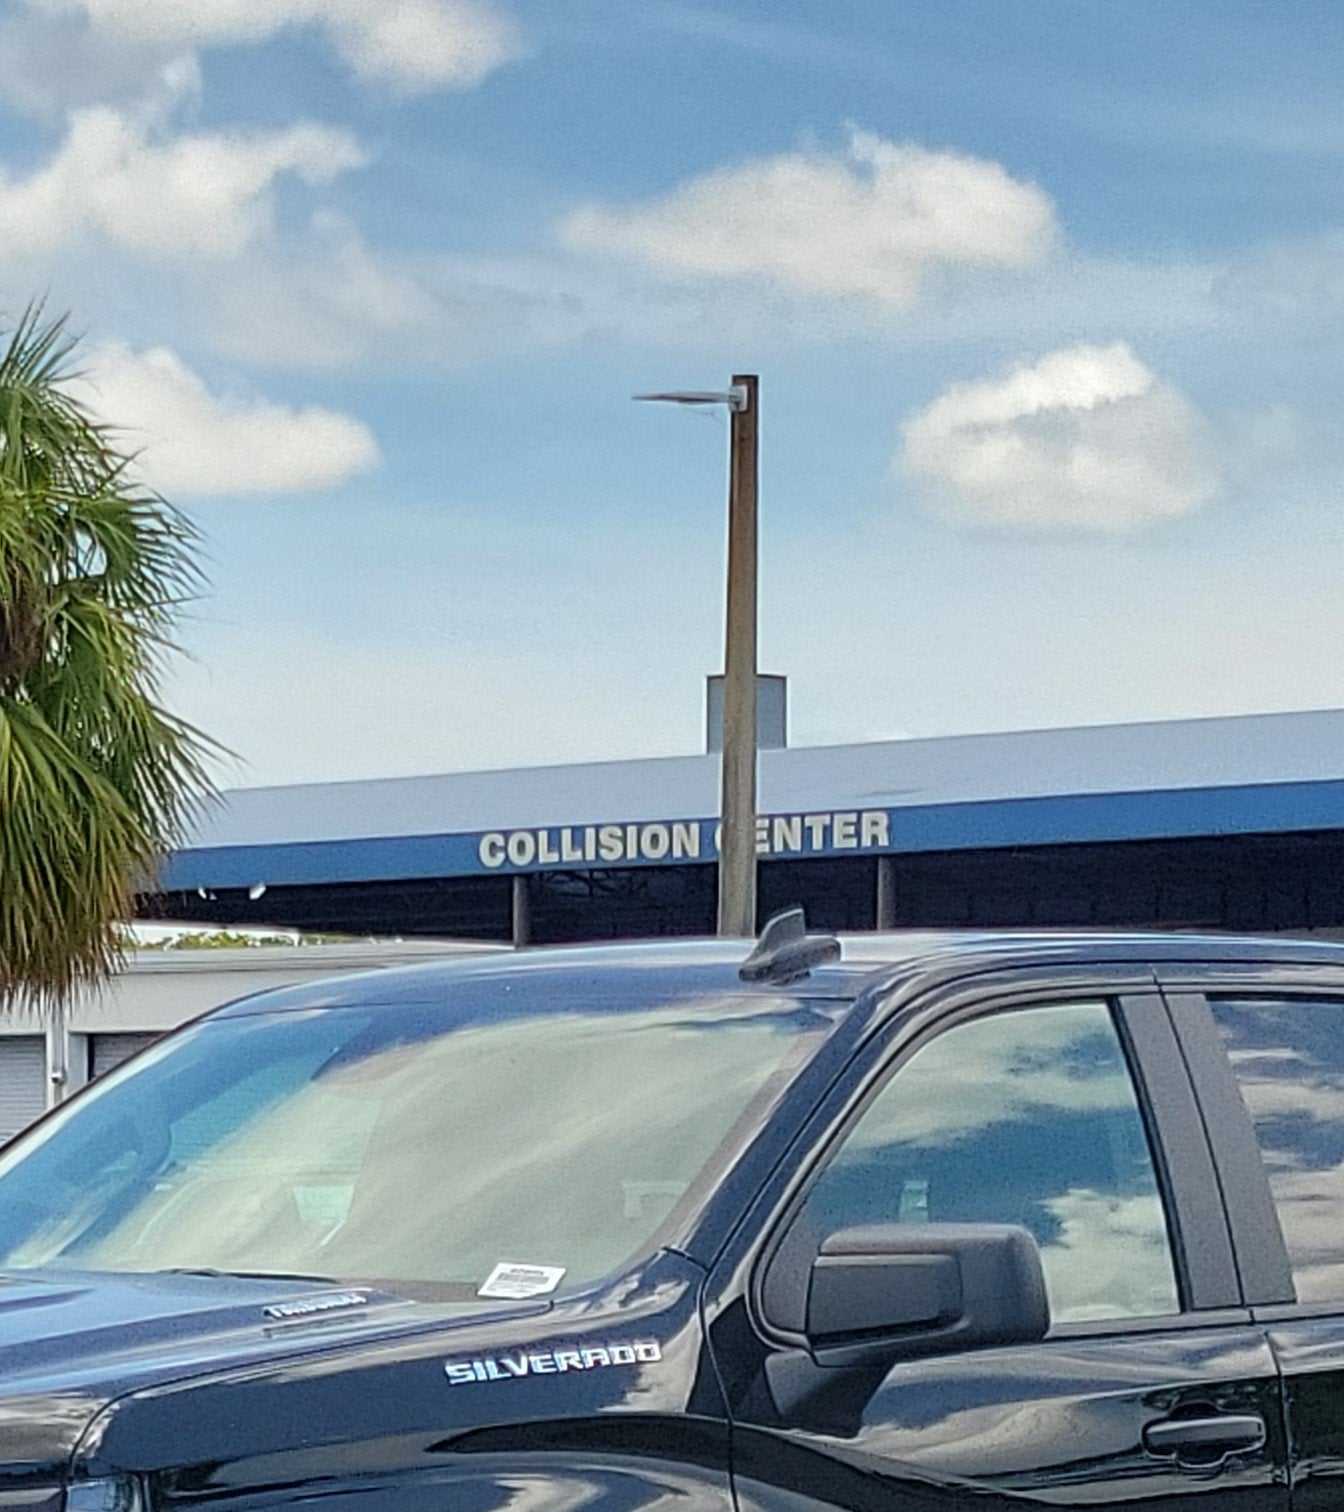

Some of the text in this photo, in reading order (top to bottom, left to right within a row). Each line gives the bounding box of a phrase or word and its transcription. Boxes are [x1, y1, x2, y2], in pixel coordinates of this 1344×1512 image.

[479, 811, 889, 868] COLLISION ENTER
[445, 1341, 662, 1385] SILVERADO
